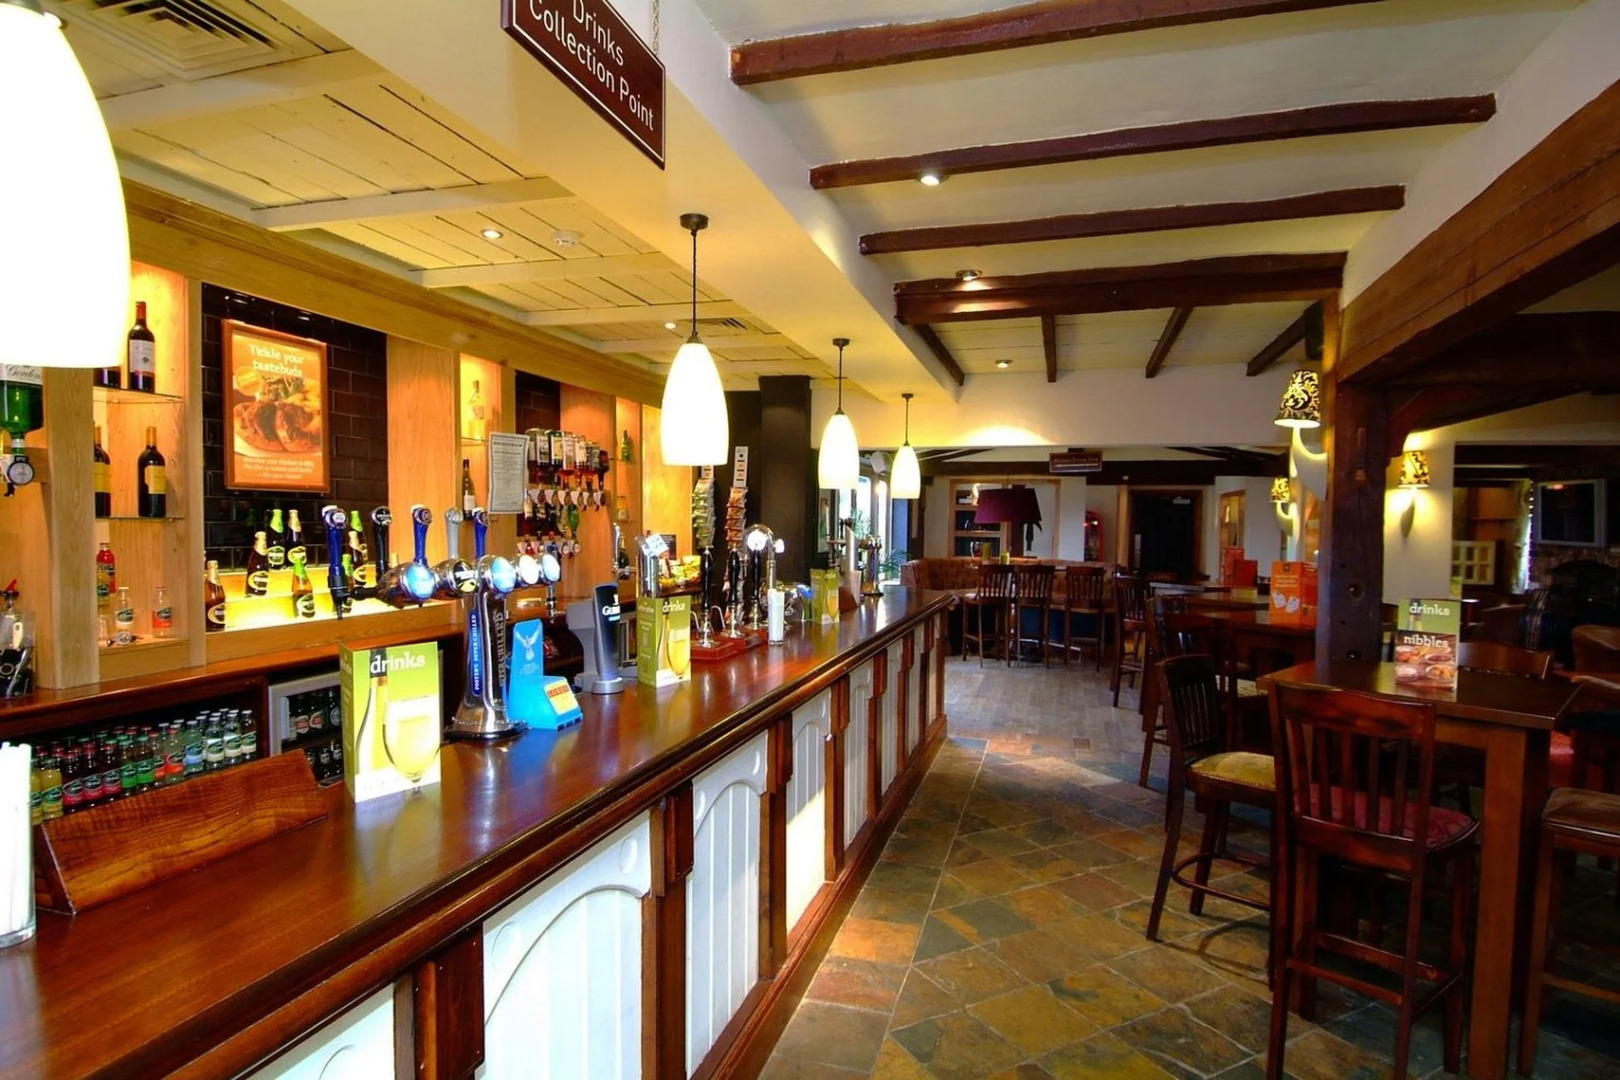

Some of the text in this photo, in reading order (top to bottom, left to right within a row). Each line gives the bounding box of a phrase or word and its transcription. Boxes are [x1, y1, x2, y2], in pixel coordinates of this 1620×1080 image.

[573, 0, 624, 66] Drinks
[529, 0, 655, 131] Collection Point
[250, 344, 304, 365] Tickle your
[252, 359, 303, 377] tastebuds
[662, 601, 685, 613] drinks
[1409, 603, 1450, 615] drinks
[1404, 635, 1448, 648] nibbles
[371, 652, 425, 673] drinks
